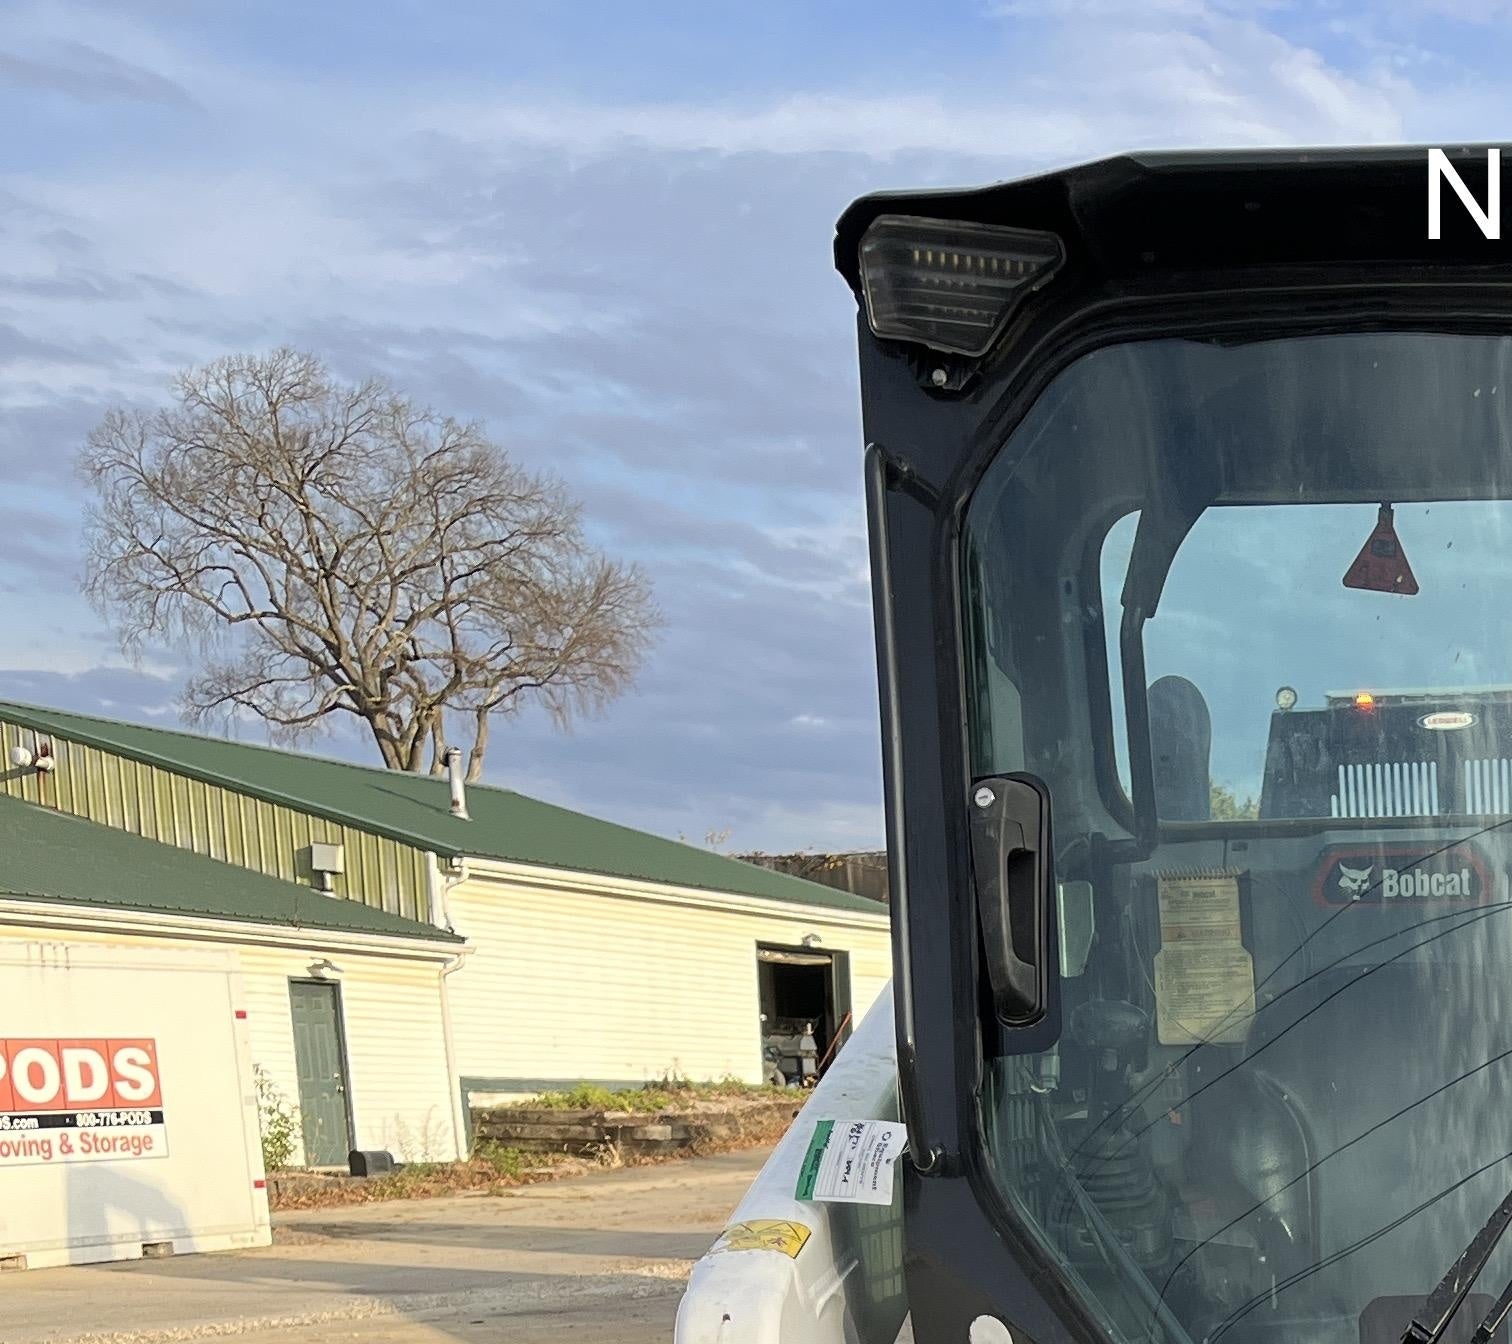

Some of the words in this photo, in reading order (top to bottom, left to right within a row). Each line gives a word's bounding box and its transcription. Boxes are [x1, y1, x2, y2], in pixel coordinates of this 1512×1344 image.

[1382, 868, 1470, 898] Bobcat
[0, 1047, 157, 1104] ODS
[0, 1116, 39, 1130] S.com
[0, 1134, 53, 1161] oving
[58, 1132, 75, 1156] &
[79, 1132, 153, 1156] Storage
